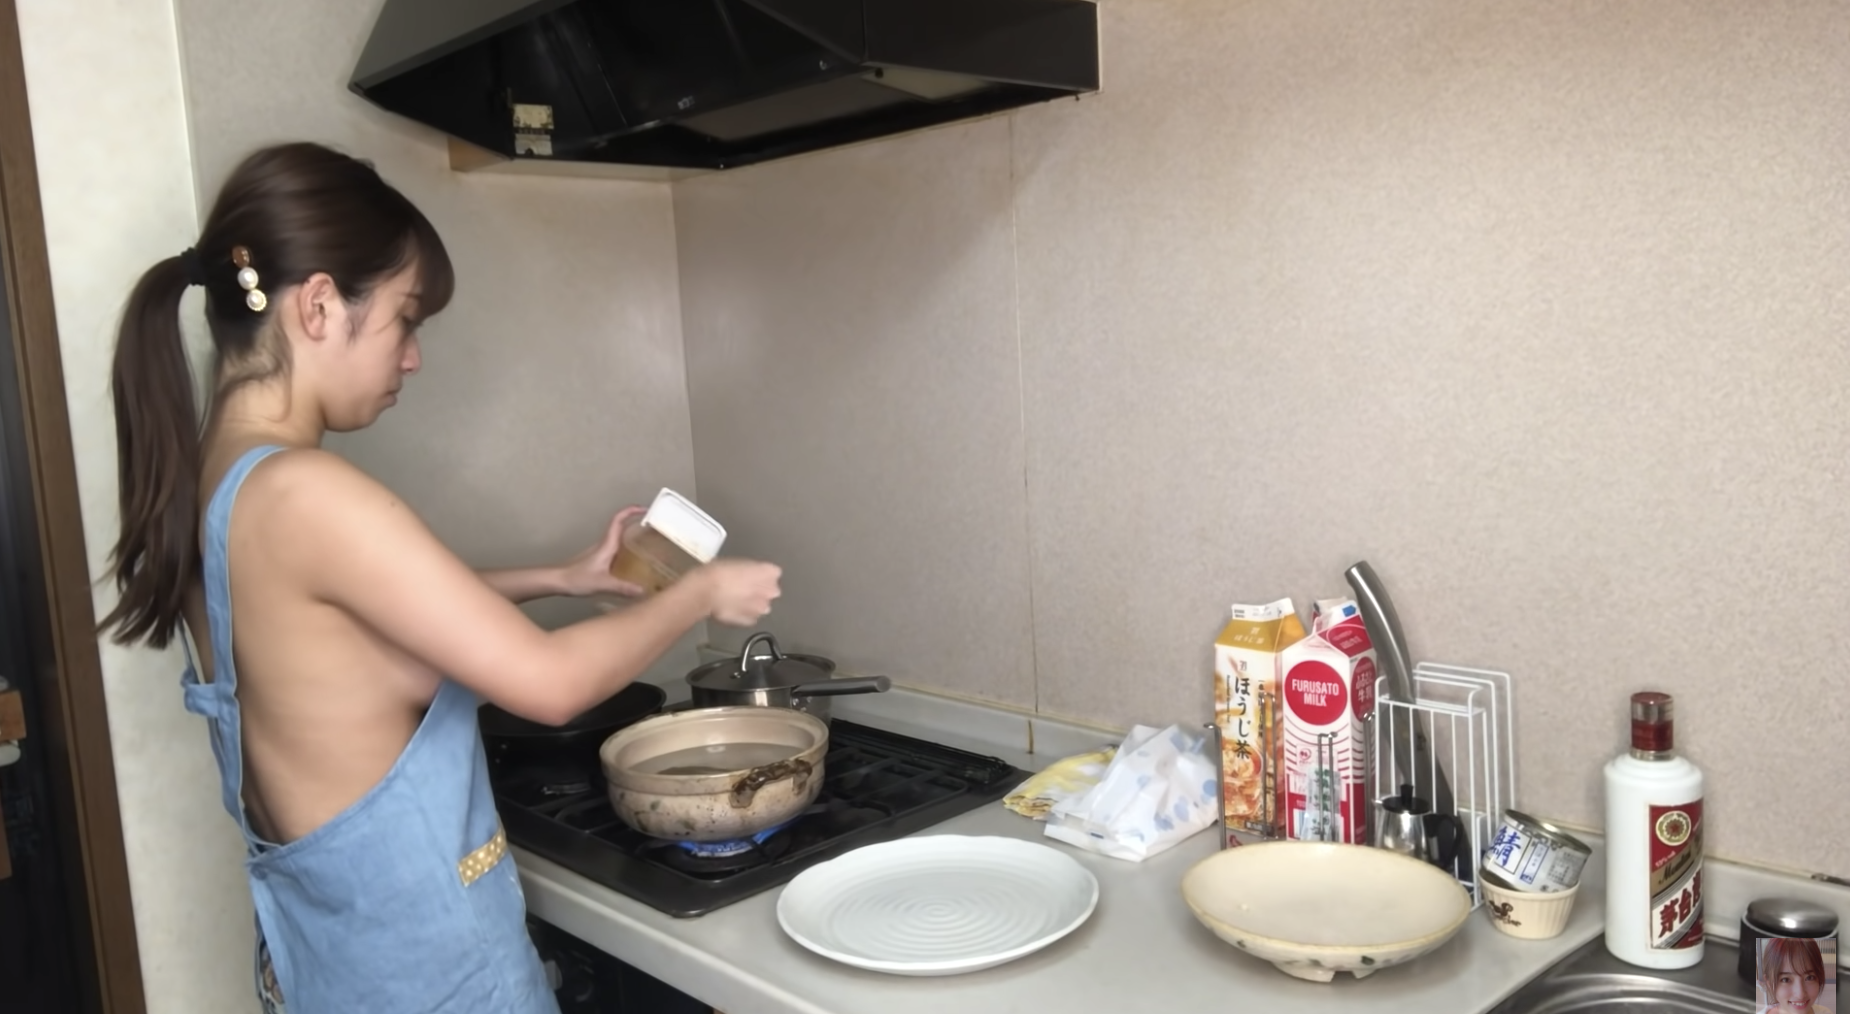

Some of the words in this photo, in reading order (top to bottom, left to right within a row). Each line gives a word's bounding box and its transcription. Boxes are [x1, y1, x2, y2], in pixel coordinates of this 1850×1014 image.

[1291, 678, 1339, 696] FURUSATO
[1303, 692, 1327, 707] MILK
[1232, 675, 1252, 760] ほうじ茶
